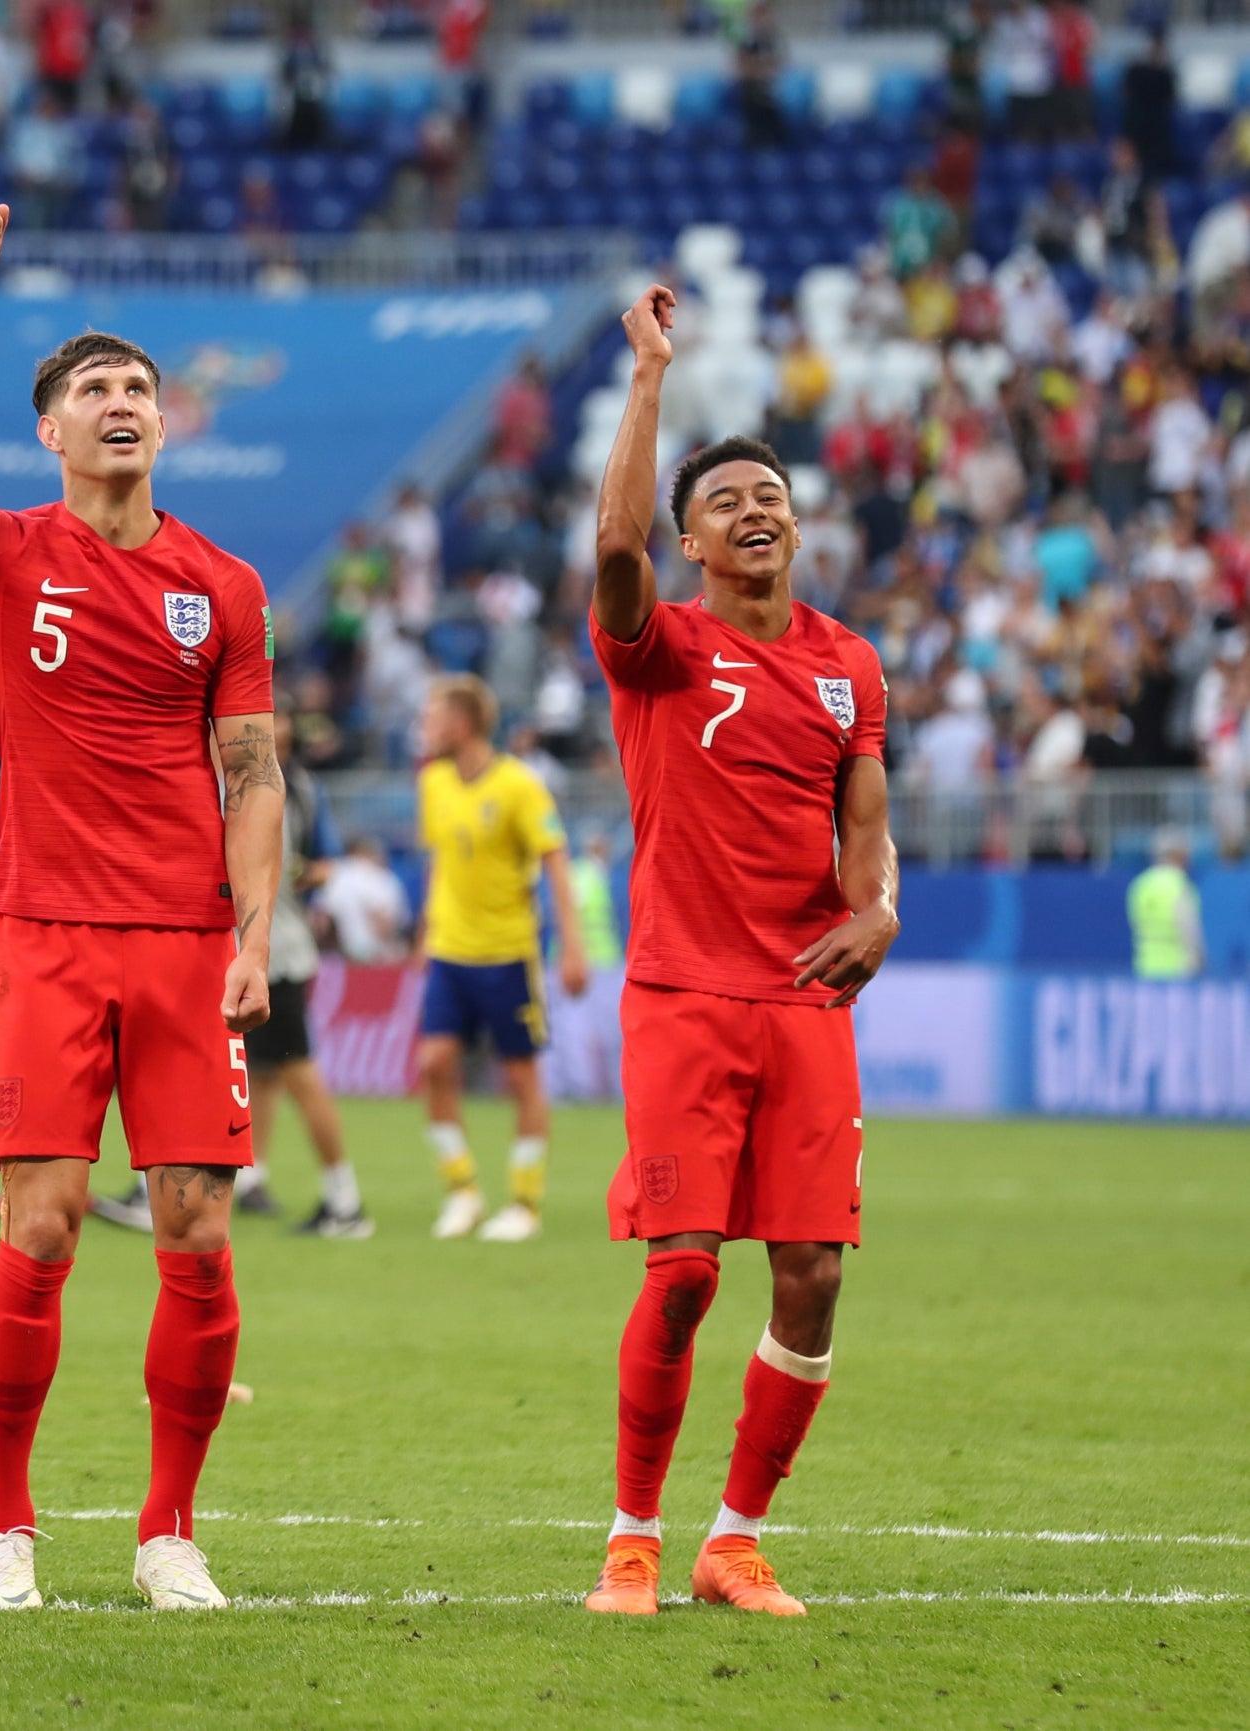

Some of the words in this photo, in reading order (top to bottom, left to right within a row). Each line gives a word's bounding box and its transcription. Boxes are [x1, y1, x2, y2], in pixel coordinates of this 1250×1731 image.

[30, 601, 73, 673] 5
[701, 678, 747, 749] 7
[228, 1038, 250, 1109] 5
